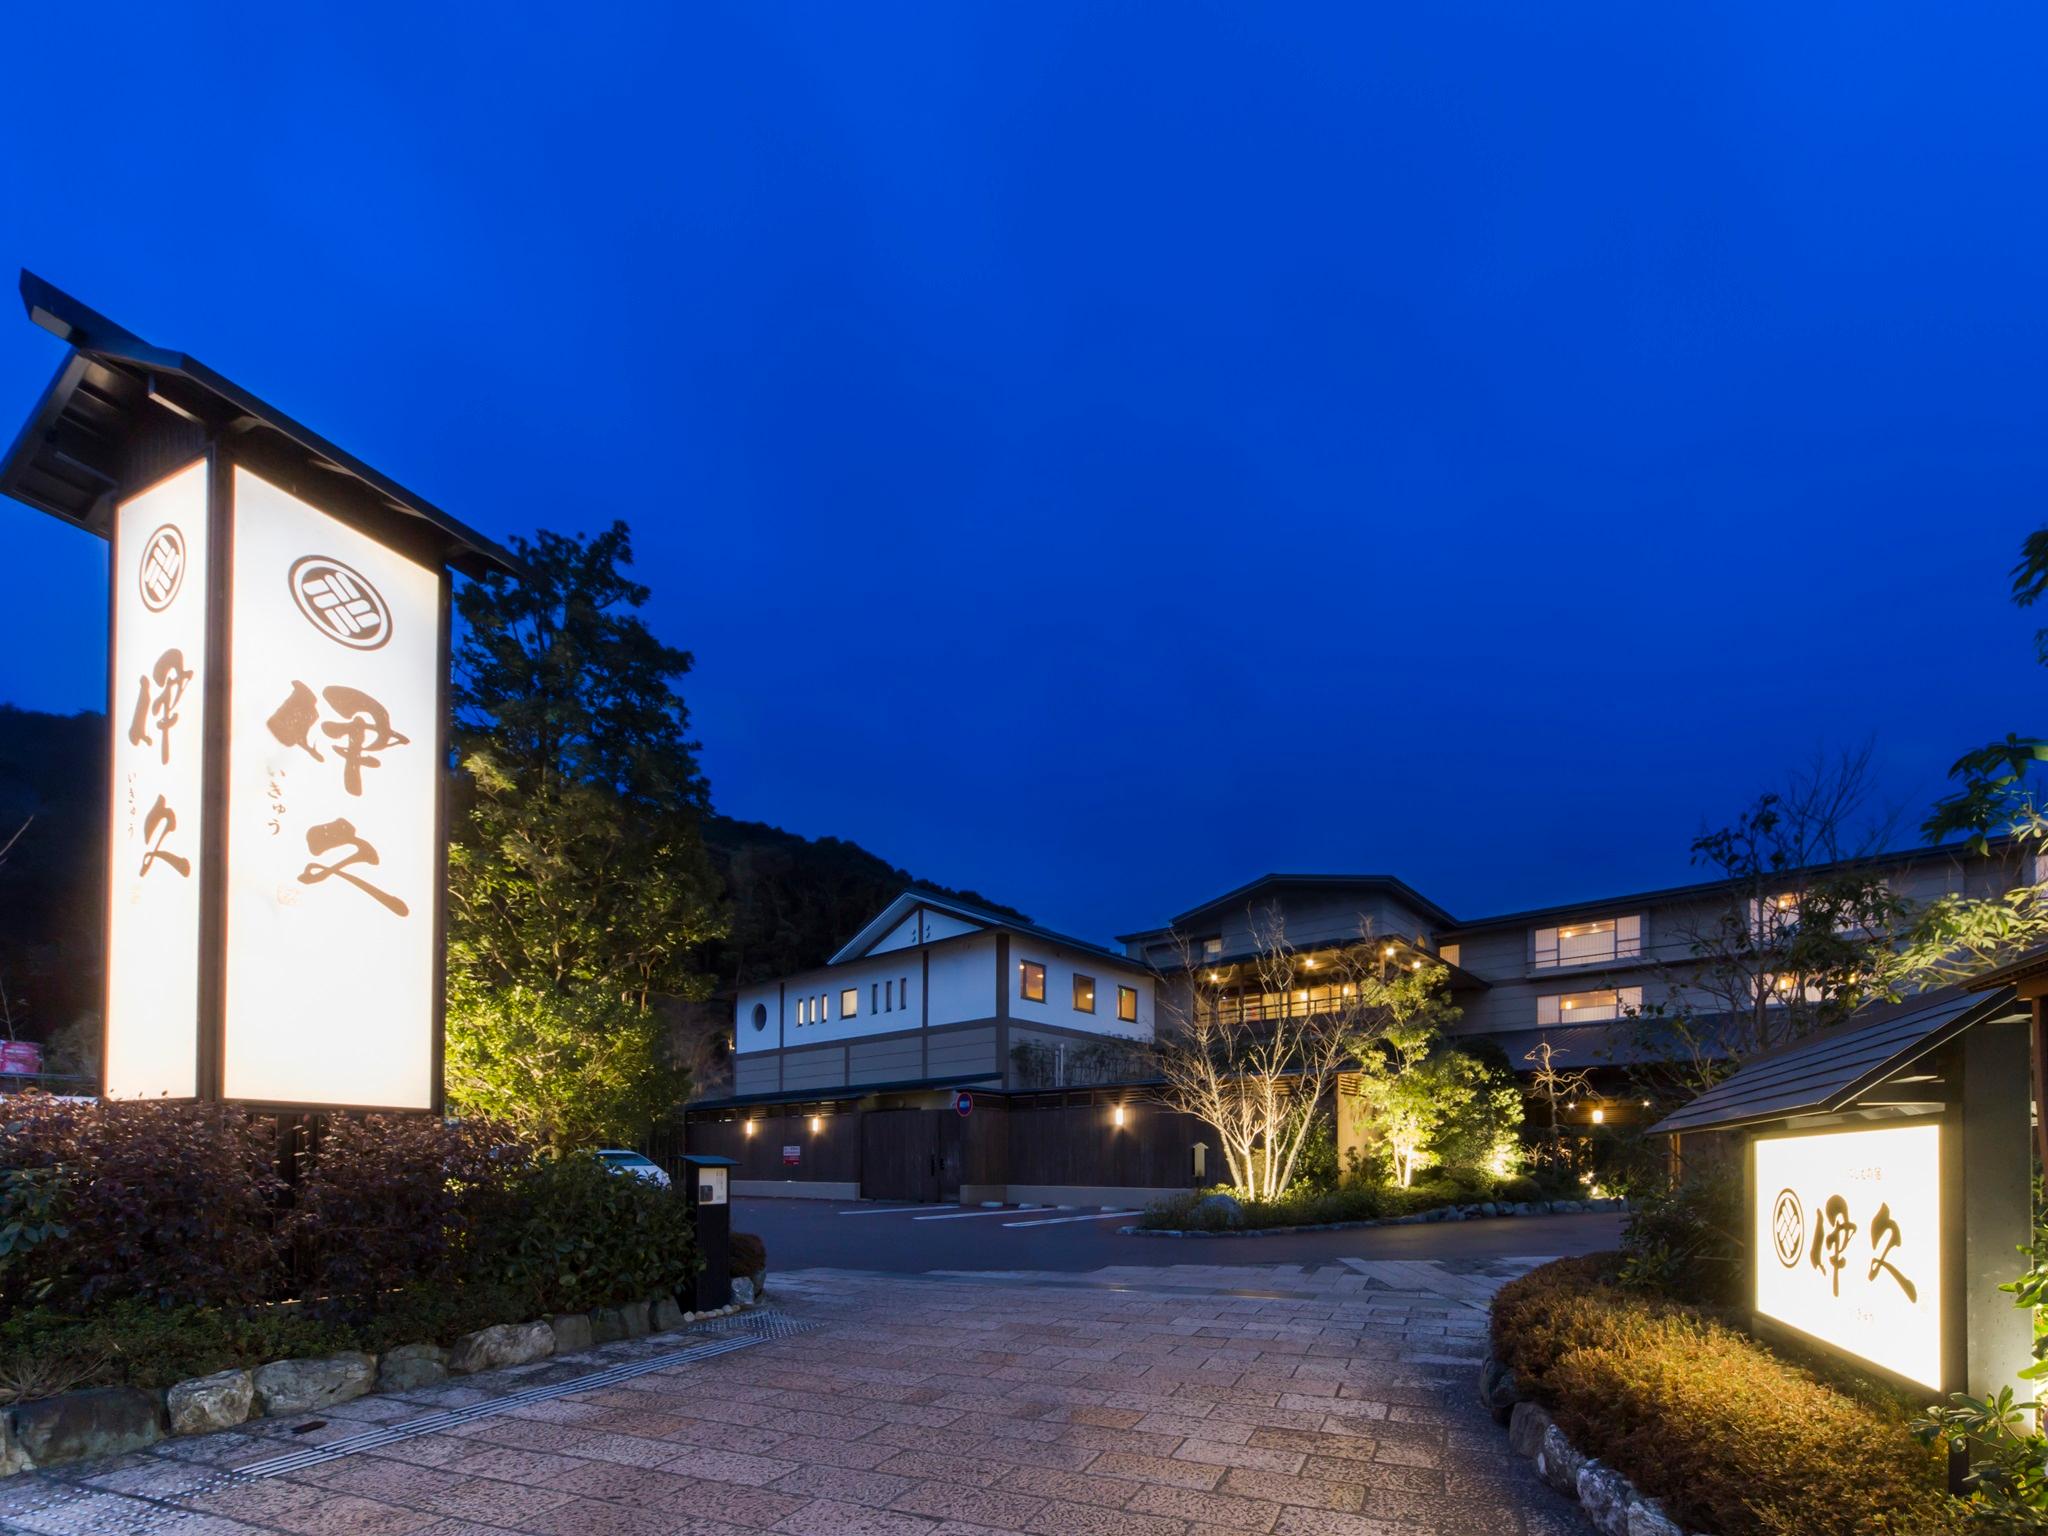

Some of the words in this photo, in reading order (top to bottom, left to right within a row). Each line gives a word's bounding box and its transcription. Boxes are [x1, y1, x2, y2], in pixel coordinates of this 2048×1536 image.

[128, 648, 194, 878] 伊久
[266, 679, 411, 918] 伊久
[1809, 1194, 1918, 1304] 伊久
